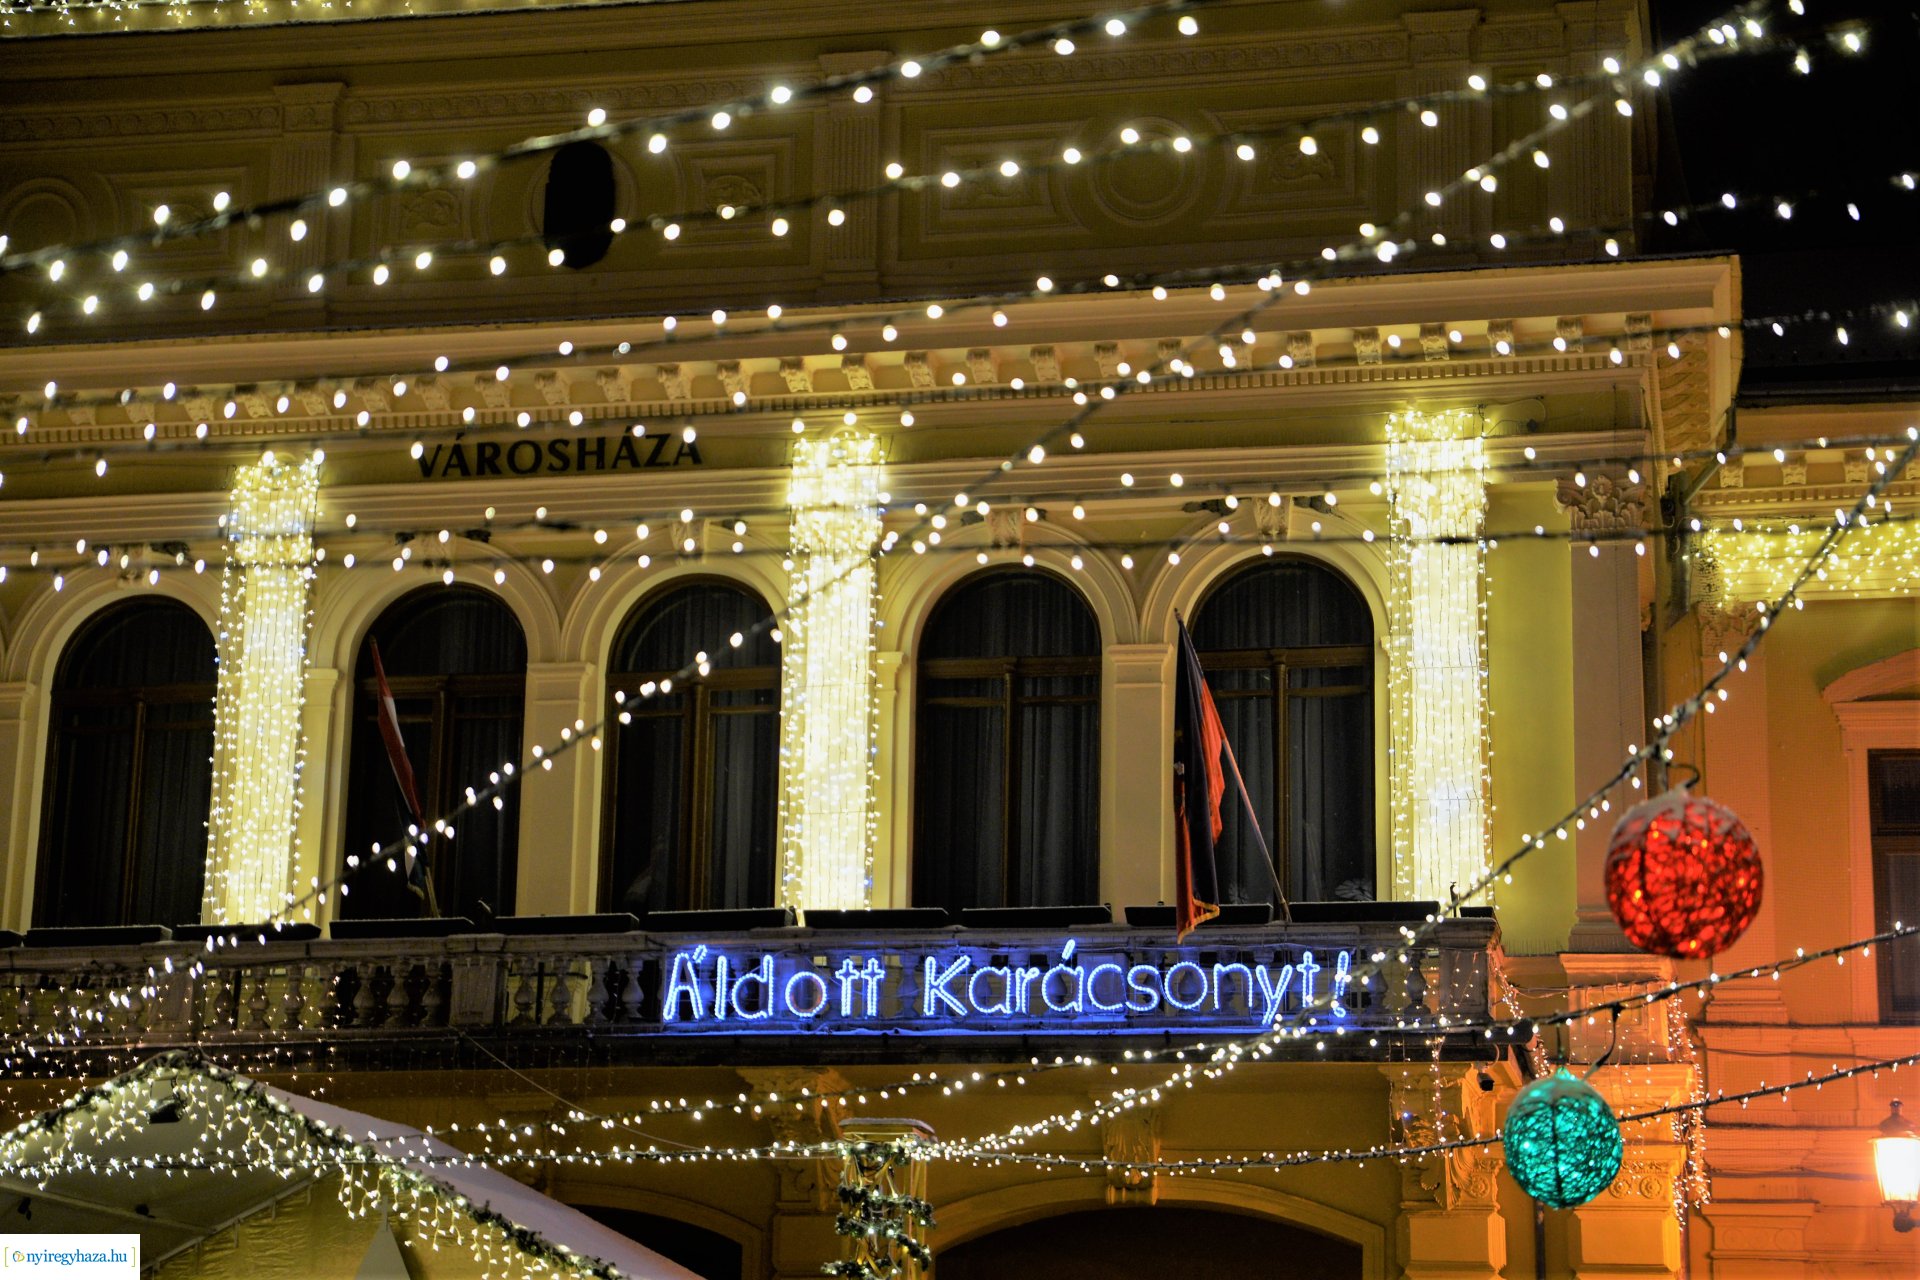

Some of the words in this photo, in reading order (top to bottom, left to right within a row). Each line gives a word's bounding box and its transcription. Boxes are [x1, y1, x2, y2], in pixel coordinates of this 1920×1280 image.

[417, 425, 702, 477] VÁROSHÁZA
[663, 945, 885, 1021] Áldott
[923, 938, 1350, 1025] Karácsonyt!
